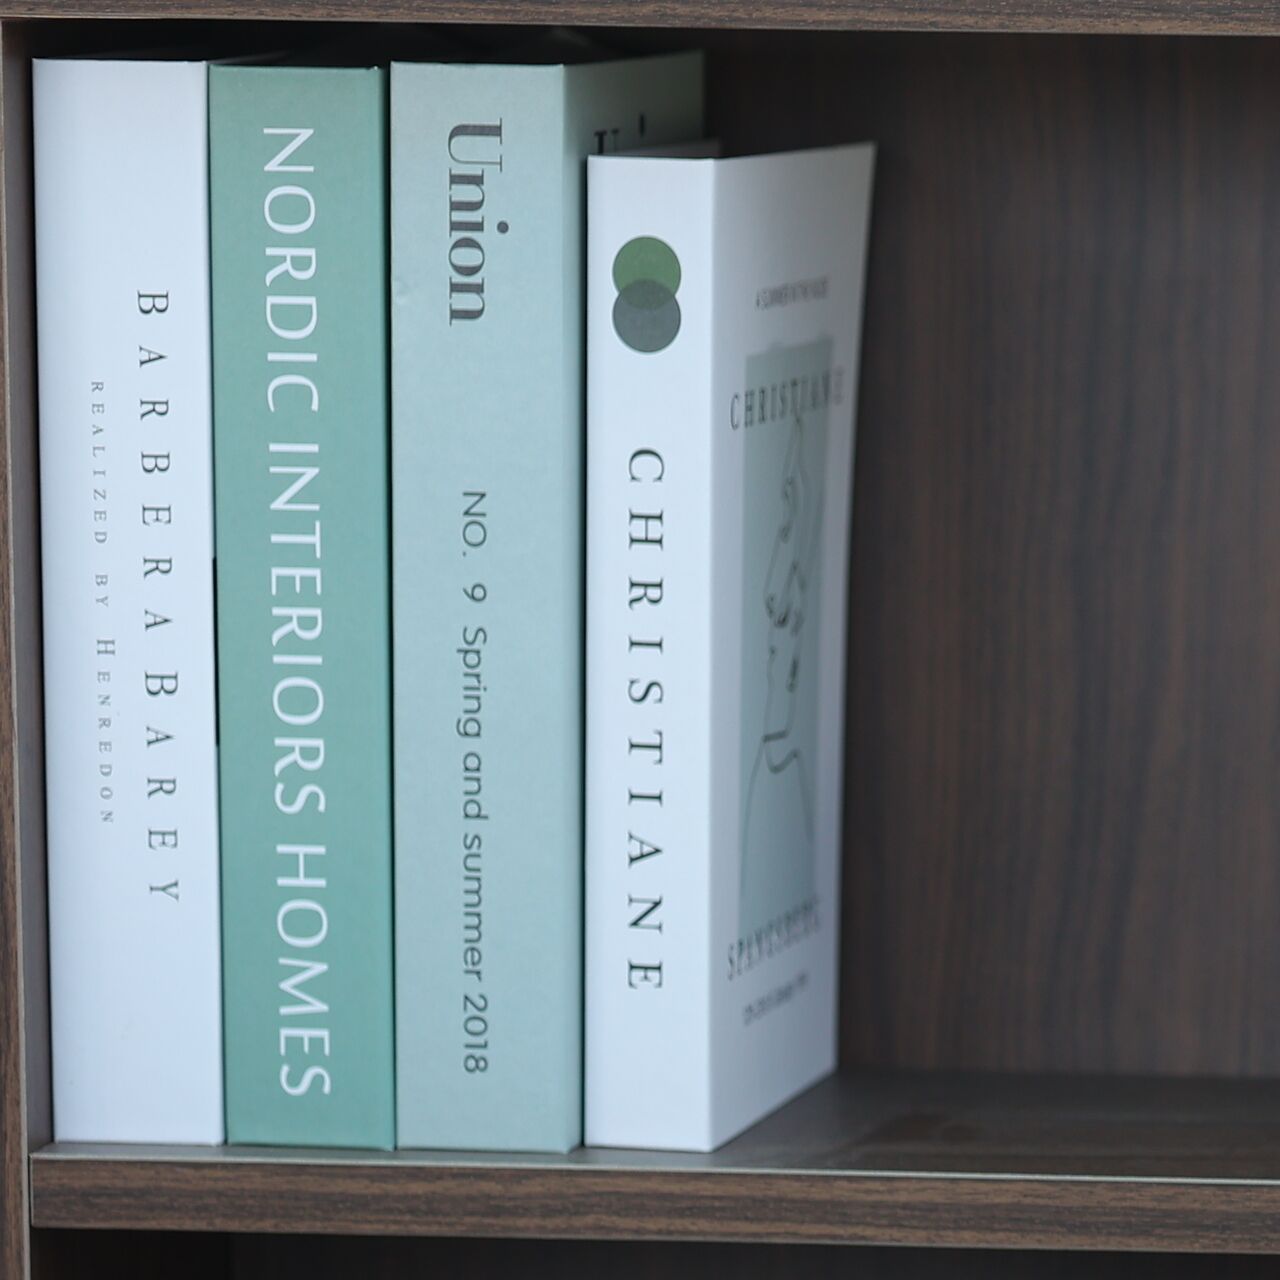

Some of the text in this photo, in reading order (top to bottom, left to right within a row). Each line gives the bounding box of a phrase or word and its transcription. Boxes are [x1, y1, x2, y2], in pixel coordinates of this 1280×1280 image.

[448, 117, 510, 325] Union
[90, 381, 116, 823] REALIZED BY HENREDON
[137, 290, 180, 901] BARBERA BAREY
[263, 127, 331, 1096] NORDIC INTERIORS HOMES
[455, 491, 489, 1074] NO. 9 Spring and summer 2018
[628, 448, 665, 988] CHRISTIANE
